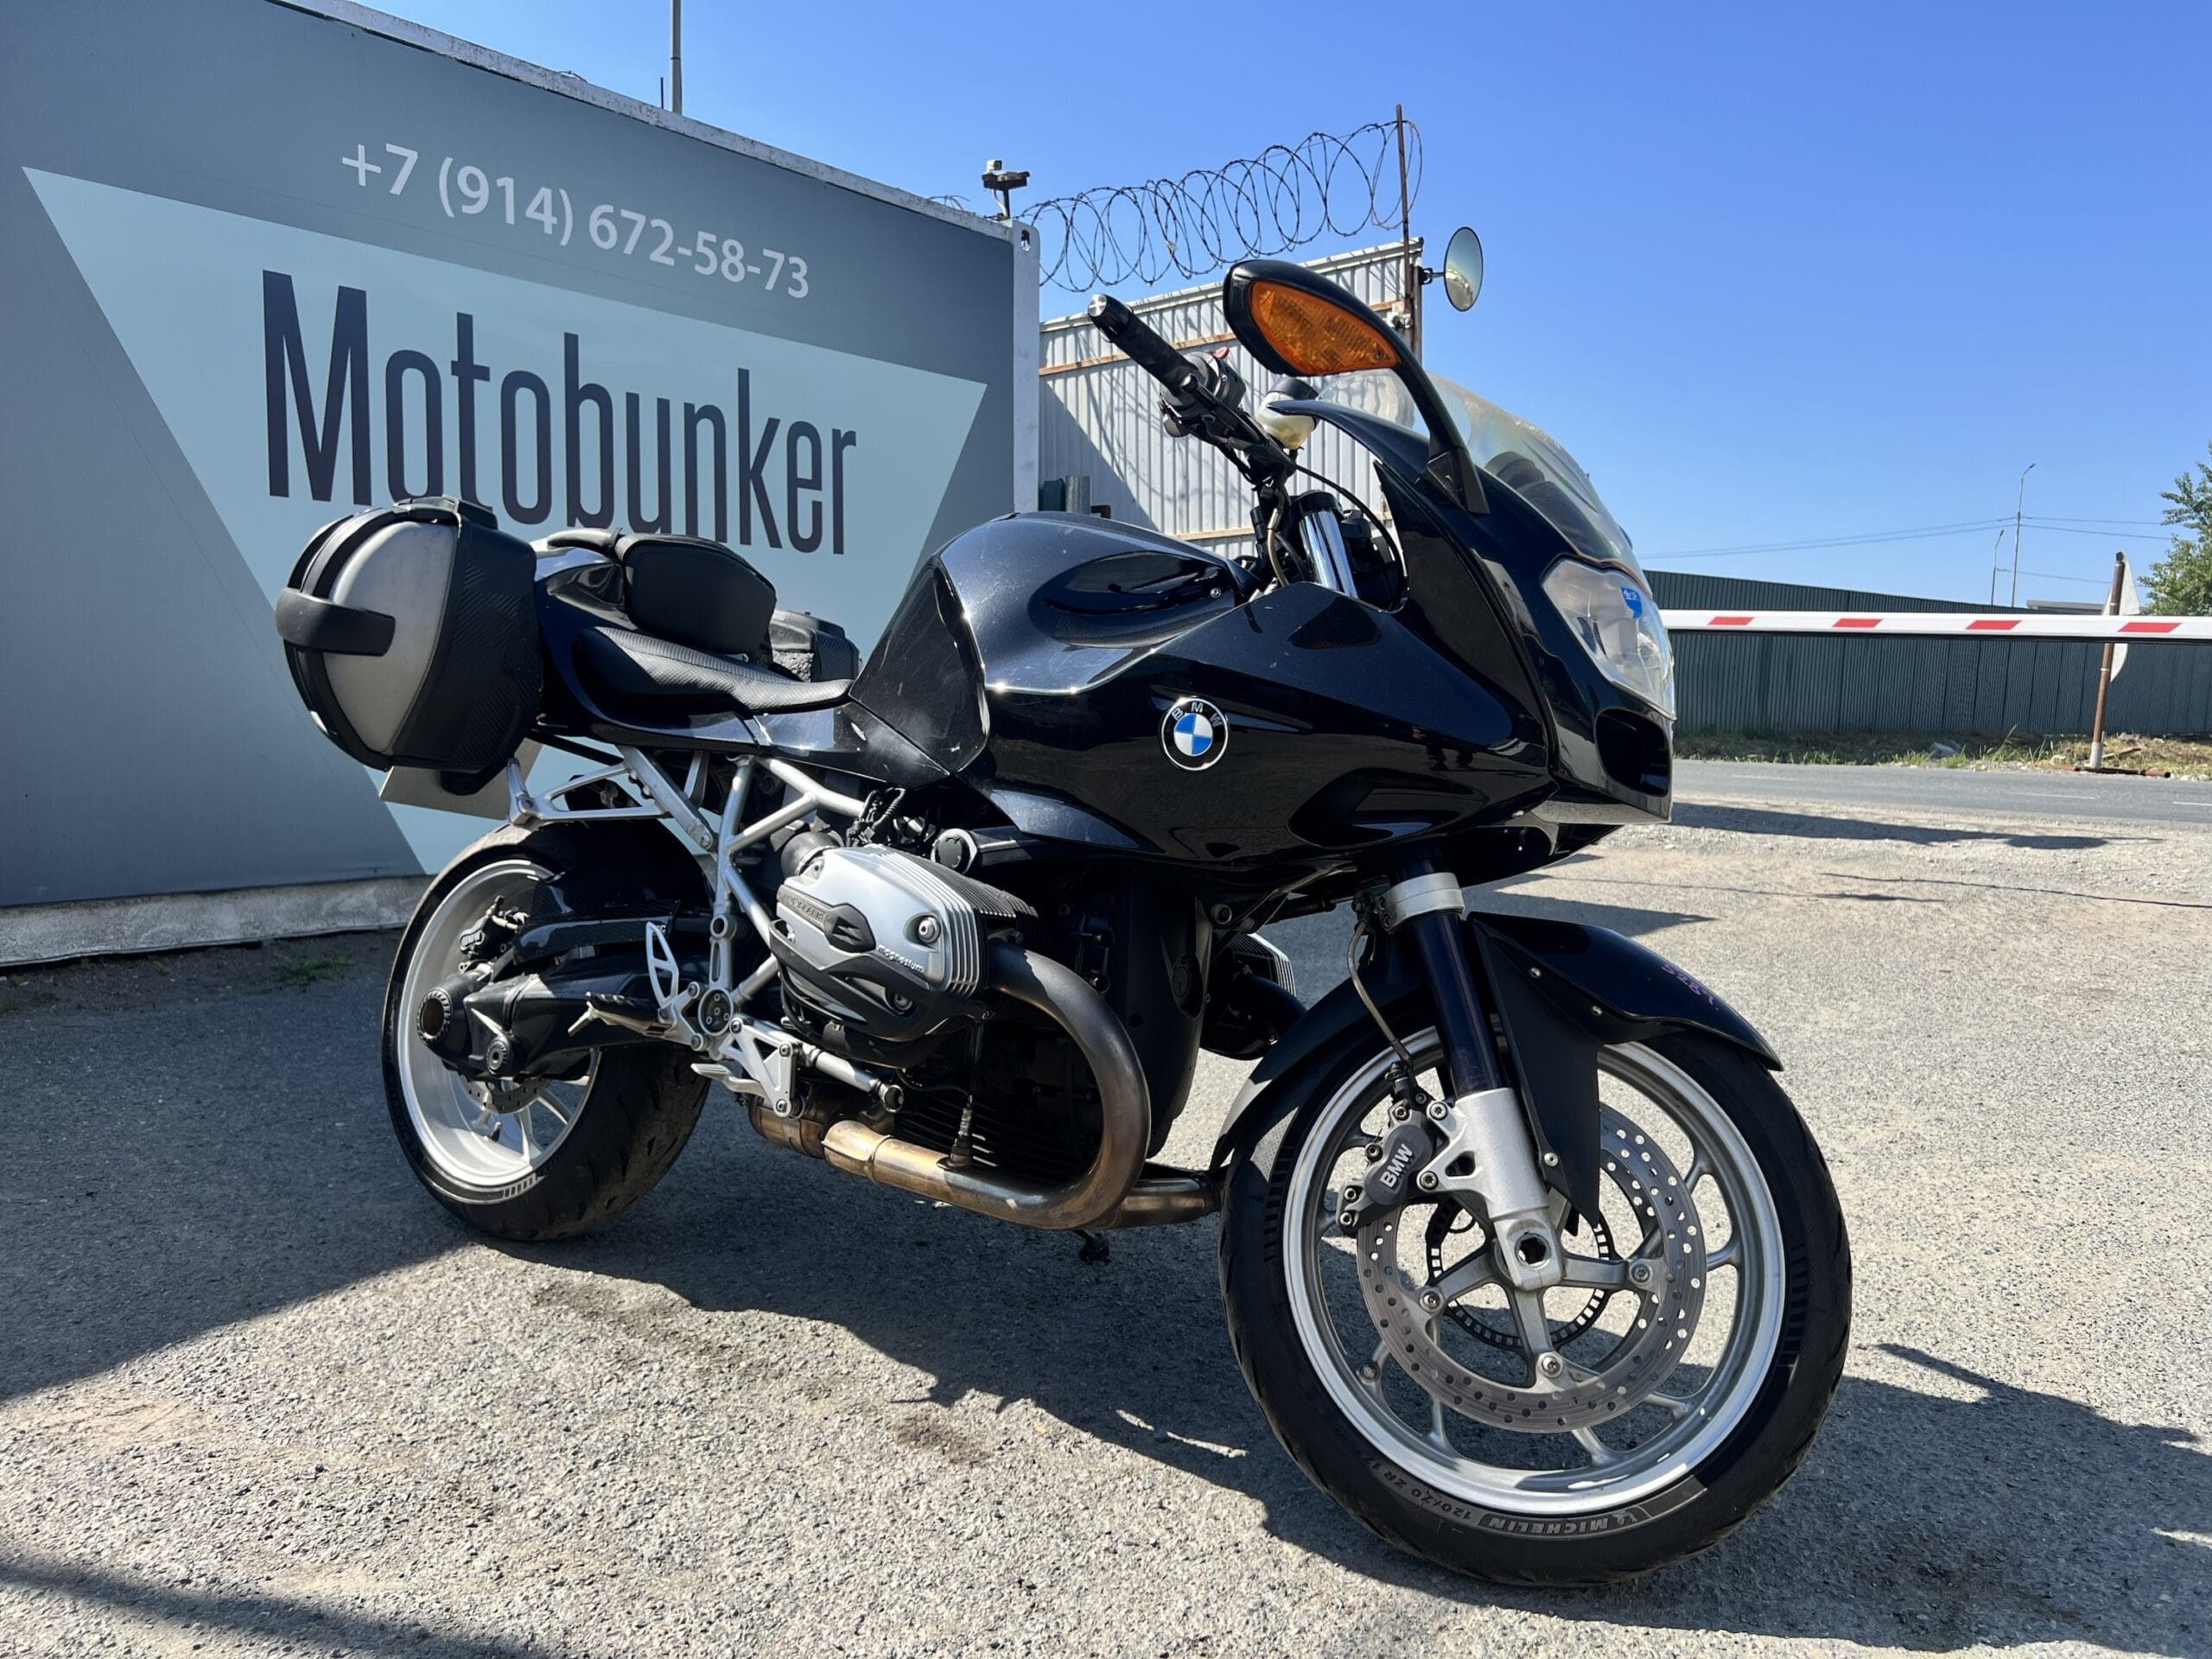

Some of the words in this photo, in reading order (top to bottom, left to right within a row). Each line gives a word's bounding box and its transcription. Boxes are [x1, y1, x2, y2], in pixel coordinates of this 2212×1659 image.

[342, 143, 418, 196] +7
[438, 156, 574, 246] (914)
[588, 204, 809, 299] 672-58-73
[262, 270, 856, 555] Motobunker
[1171, 701, 1223, 728] BMW
[1379, 1142, 1414, 1189] BMW
[1488, 1516, 1609, 1536] MICHELIN
